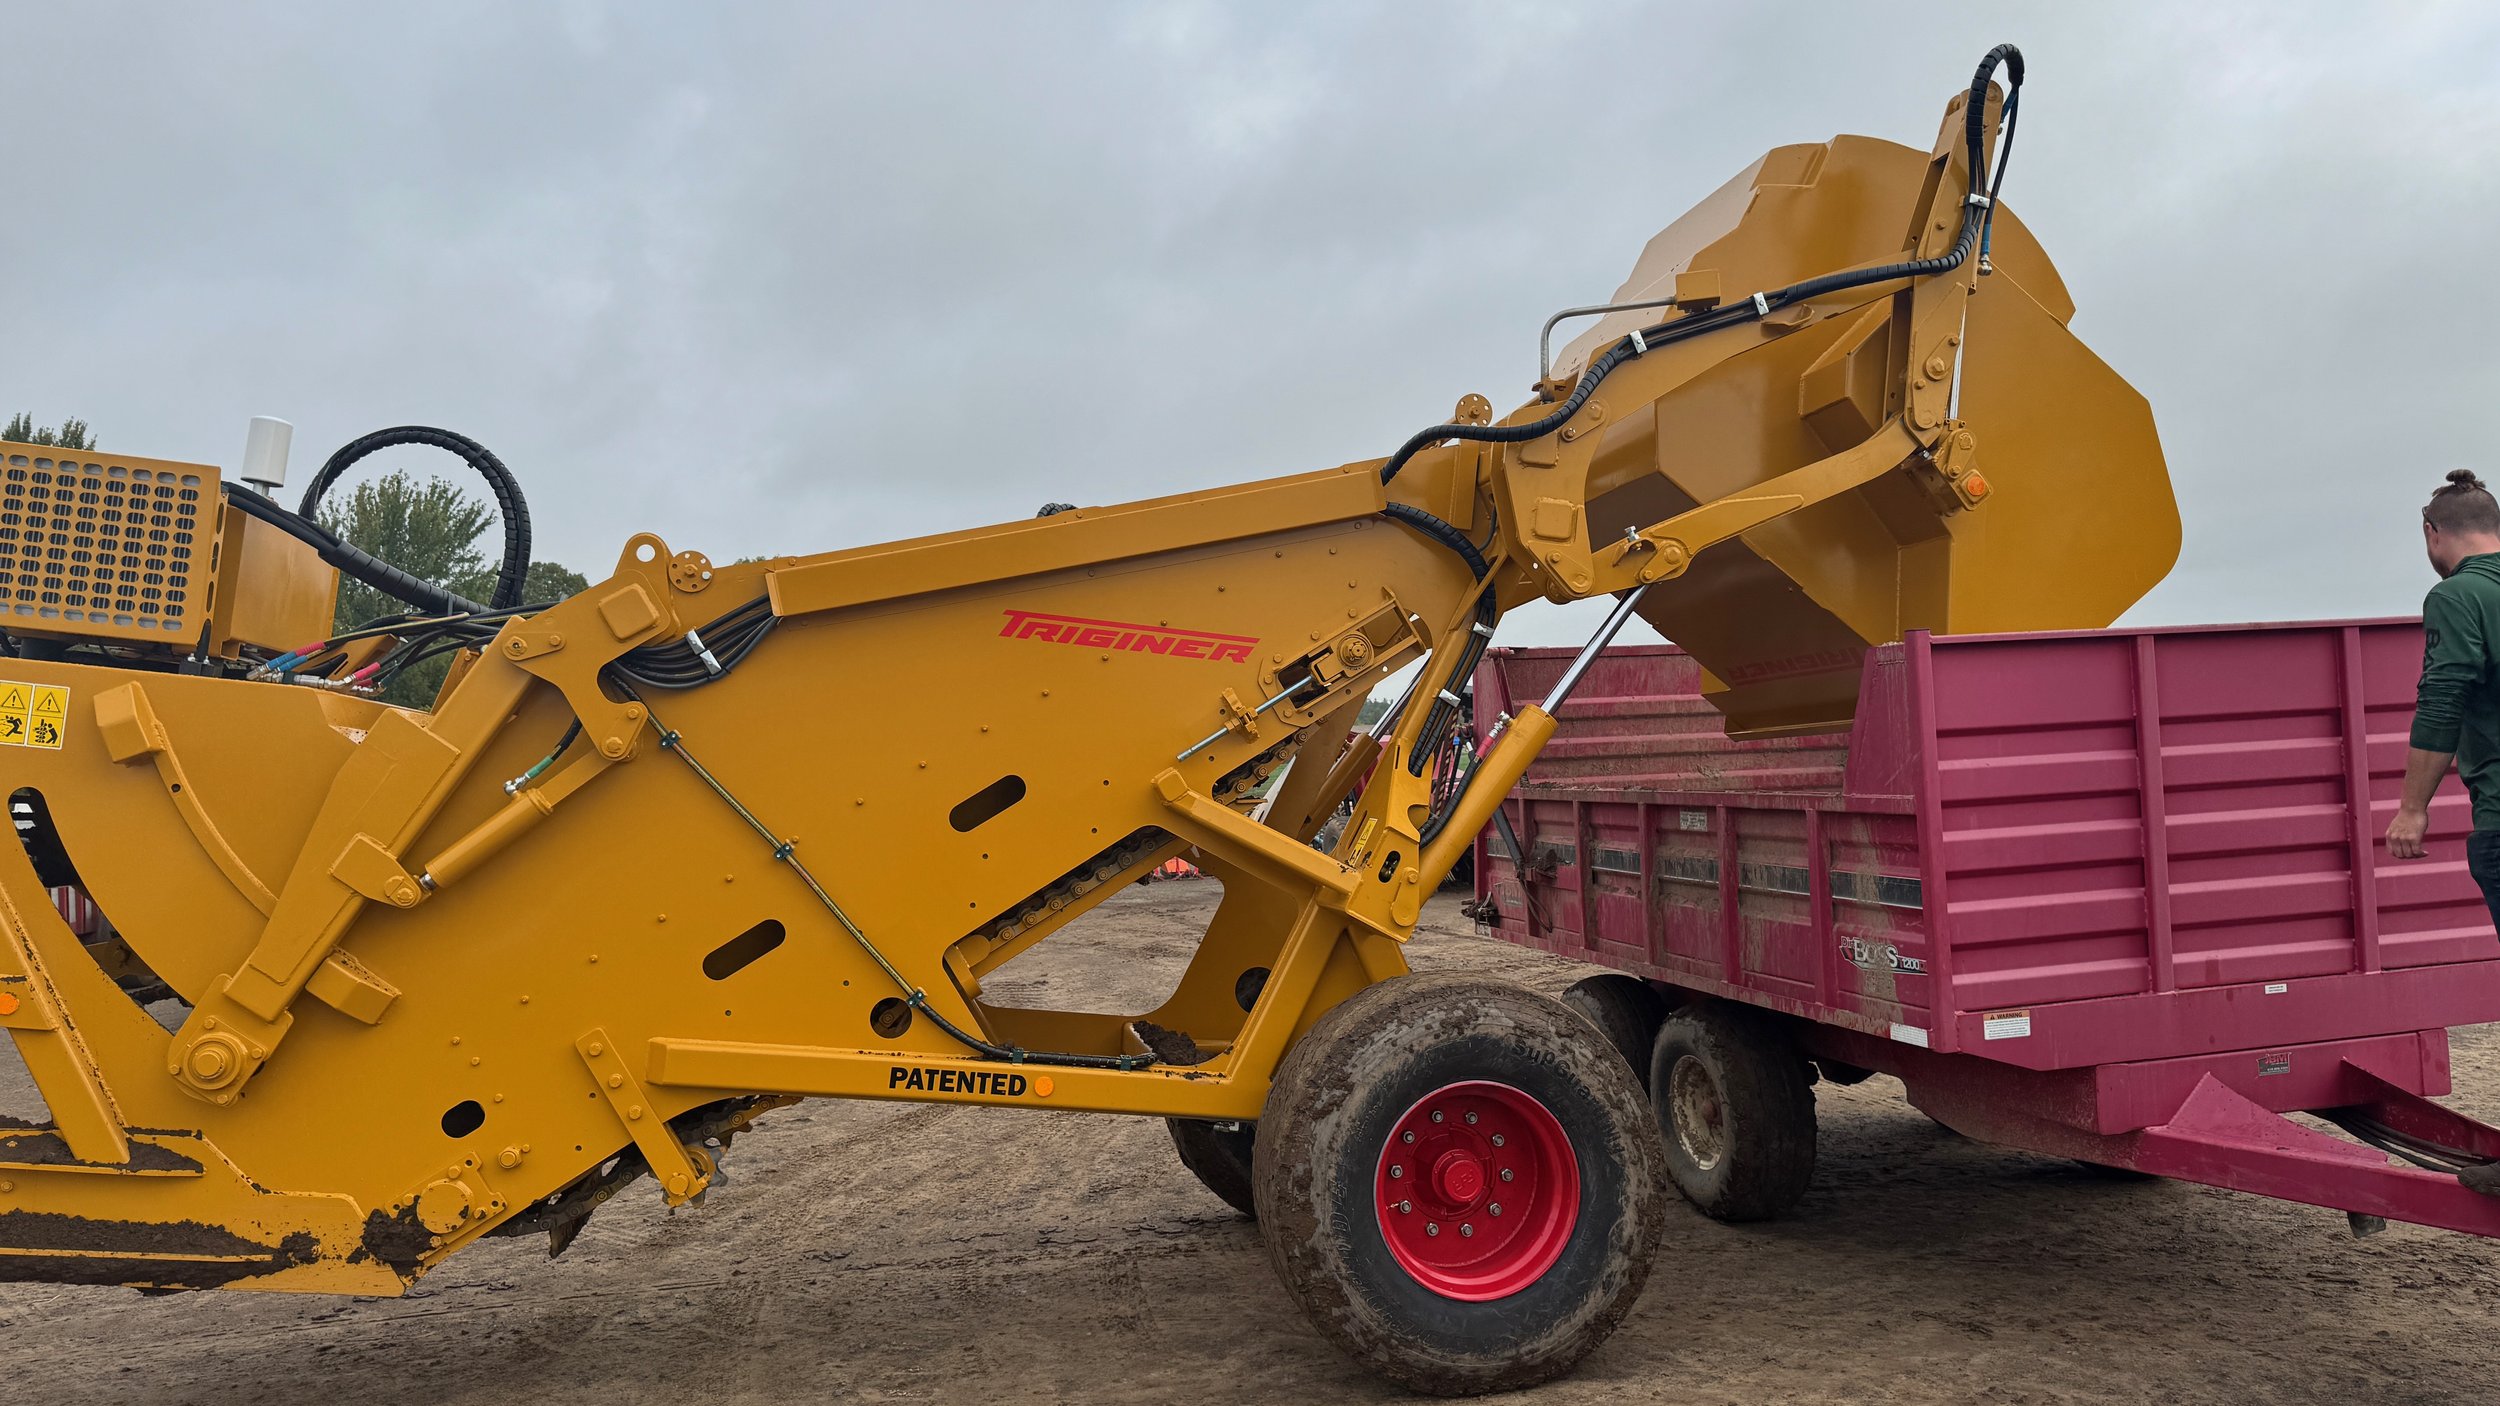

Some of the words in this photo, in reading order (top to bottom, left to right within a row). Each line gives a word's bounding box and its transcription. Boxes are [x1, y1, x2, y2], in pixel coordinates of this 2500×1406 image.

[999, 609, 1261, 664] TRIGINER
[1996, 1012, 2023, 1020] WARNING
[888, 1066, 1027, 1097] PATENTED
